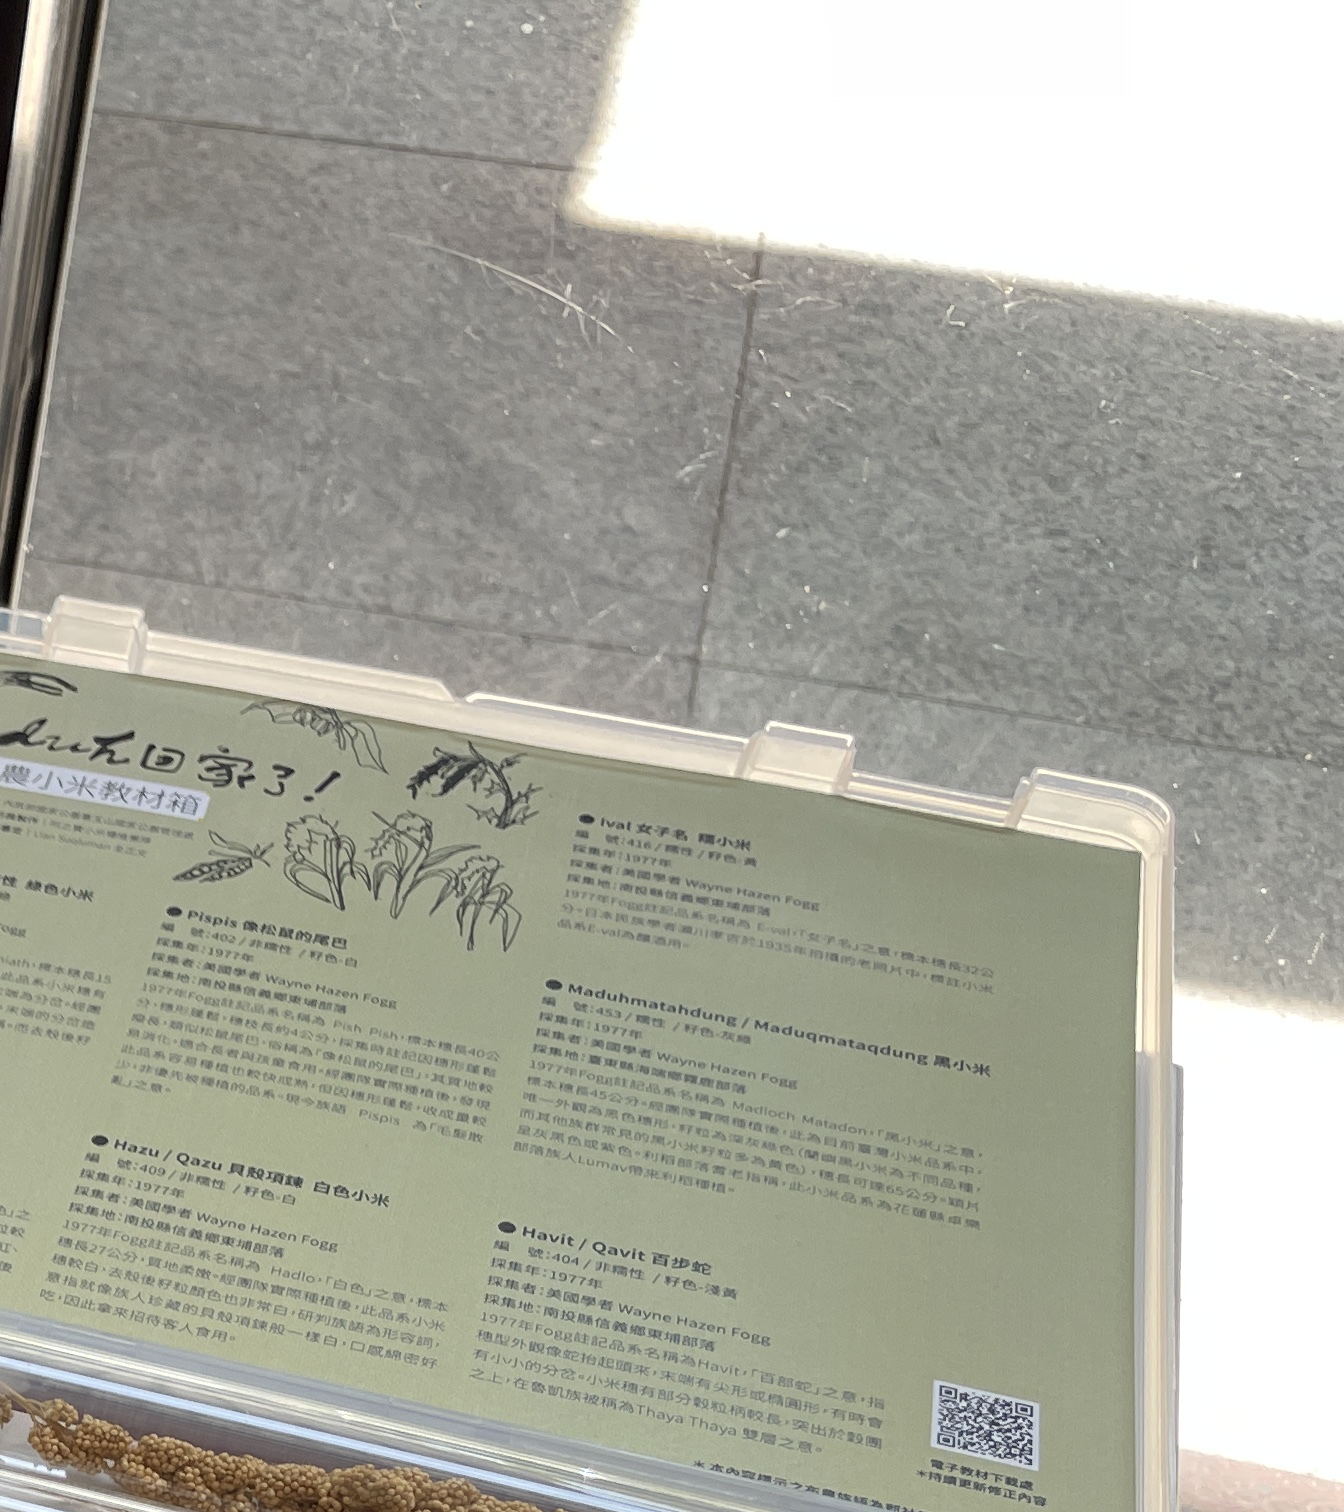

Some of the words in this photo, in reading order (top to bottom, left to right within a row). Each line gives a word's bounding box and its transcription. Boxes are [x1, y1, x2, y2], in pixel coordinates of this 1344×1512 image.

[185, 909, 238, 930] Pispis
[241, 918, 349, 951] 像松鼠的尾巴
[566, 982, 737, 1028] Maduhmatahdung
[753, 1019, 928, 1066] Maduqmataqdung
[932, 1054, 991, 1078] 黑小米
[113, 1138, 160, 1159] Hazu
[174, 1151, 223, 1173] Qazu
[312, 1178, 390, 1209] 白色小米
[194, 1210, 247, 1233] Wayne
[249, 1222, 297, 1243] Hazen
[299, 1233, 339, 1254] Fogg
[521, 1224, 575, 1248] Havit
[590, 1239, 646, 1264] Qavit
[650, 1251, 712, 1277] 百步蛇
[618, 1301, 672, 1325] Wayne
[676, 1314, 726, 1336] Hazen
[730, 1326, 772, 1348] Fogg
[688, 1414, 737, 1438] Thaya
